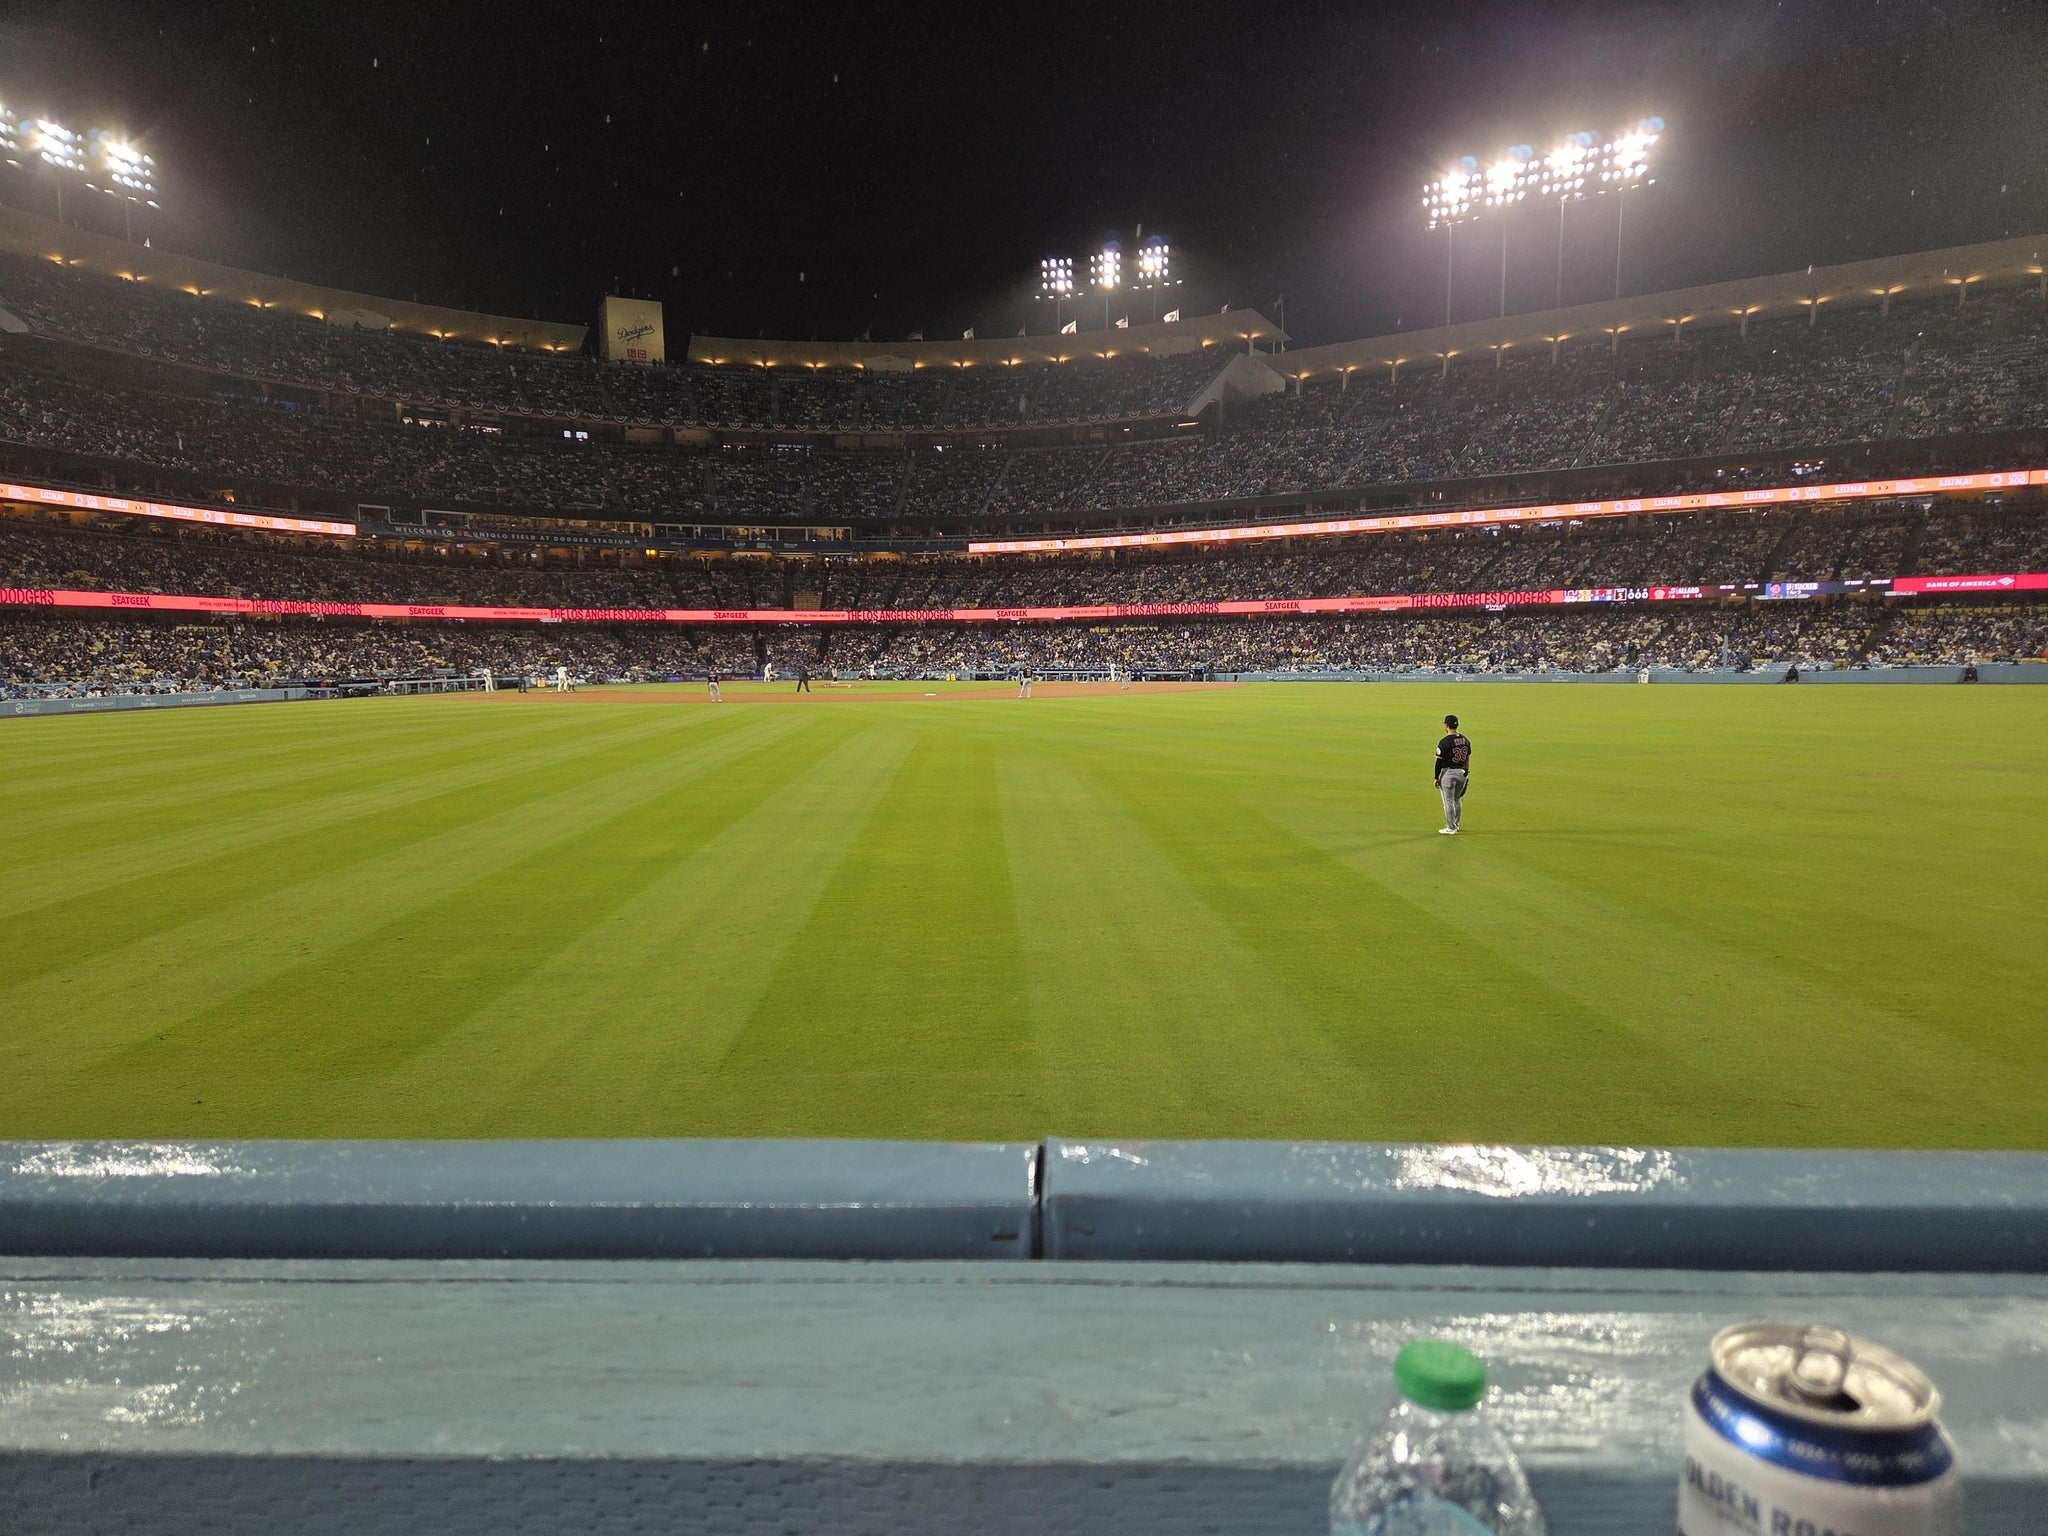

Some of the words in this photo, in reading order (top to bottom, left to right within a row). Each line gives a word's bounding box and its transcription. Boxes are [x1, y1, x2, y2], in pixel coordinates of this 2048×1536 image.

[617, 324, 656, 341] Dodgers
[395, 526, 437, 535] WELCOME
[473, 531, 508, 539] UNIQLO
[0, 588, 54, 605] DODGERS
[112, 595, 150, 606] SEATGEEK
[1411, 595, 1428, 608] THE
[1430, 594, 1450, 607] LOS
[1452, 592, 1496, 606] ANGELES
[1499, 591, 1551, 604] DODGERS
[252, 600, 267, 613] THE
[268, 600, 282, 613] LOS
[284, 601, 319, 614] ANGELES
[321, 602, 361, 615] DODGERS
[409, 607, 445, 615] SEATGEEK
[1116, 605, 1129, 616] THE
[1129, 604, 1145, 616] LOS
[1146, 604, 1179, 615] ANGELES
[1180, 603, 1219, 614] DODGERS
[1265, 601, 1300, 610] SEATGEEK
[550, 609, 565, 620] THE
[566, 609, 584, 620] LOS
[585, 609, 623, 620] ANGELES
[625, 609, 666, 620] DODGERS
[848, 610, 863, 620] THE
[863, 610, 878, 620] LOS
[880, 610, 915, 620] ANGELES
[916, 610, 954, 620] DODGERS
